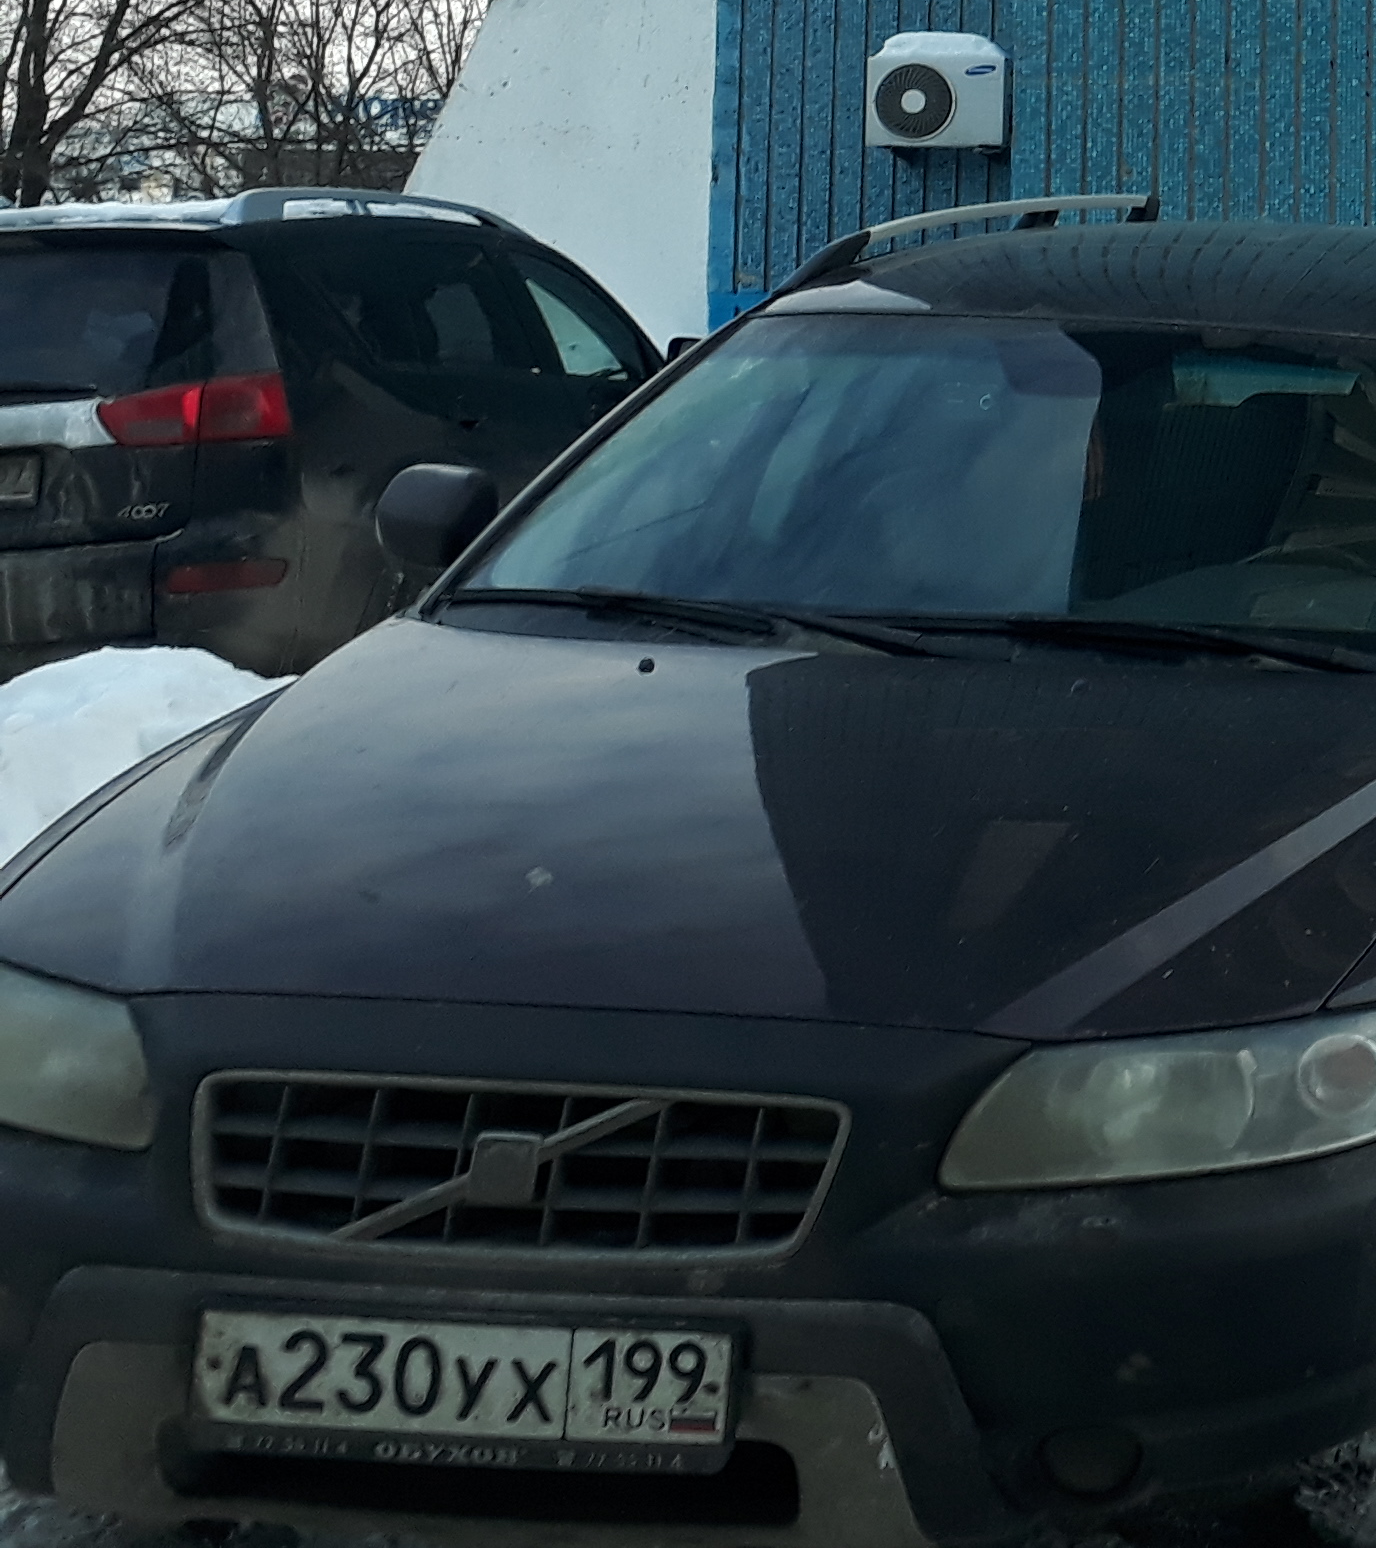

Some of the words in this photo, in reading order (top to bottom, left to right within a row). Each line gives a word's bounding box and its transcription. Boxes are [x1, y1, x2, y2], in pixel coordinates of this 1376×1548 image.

[224, 1329, 557, 1424] А230УХ
[582, 1338, 709, 1404] 199
[602, 1406, 668, 1432] RUS
